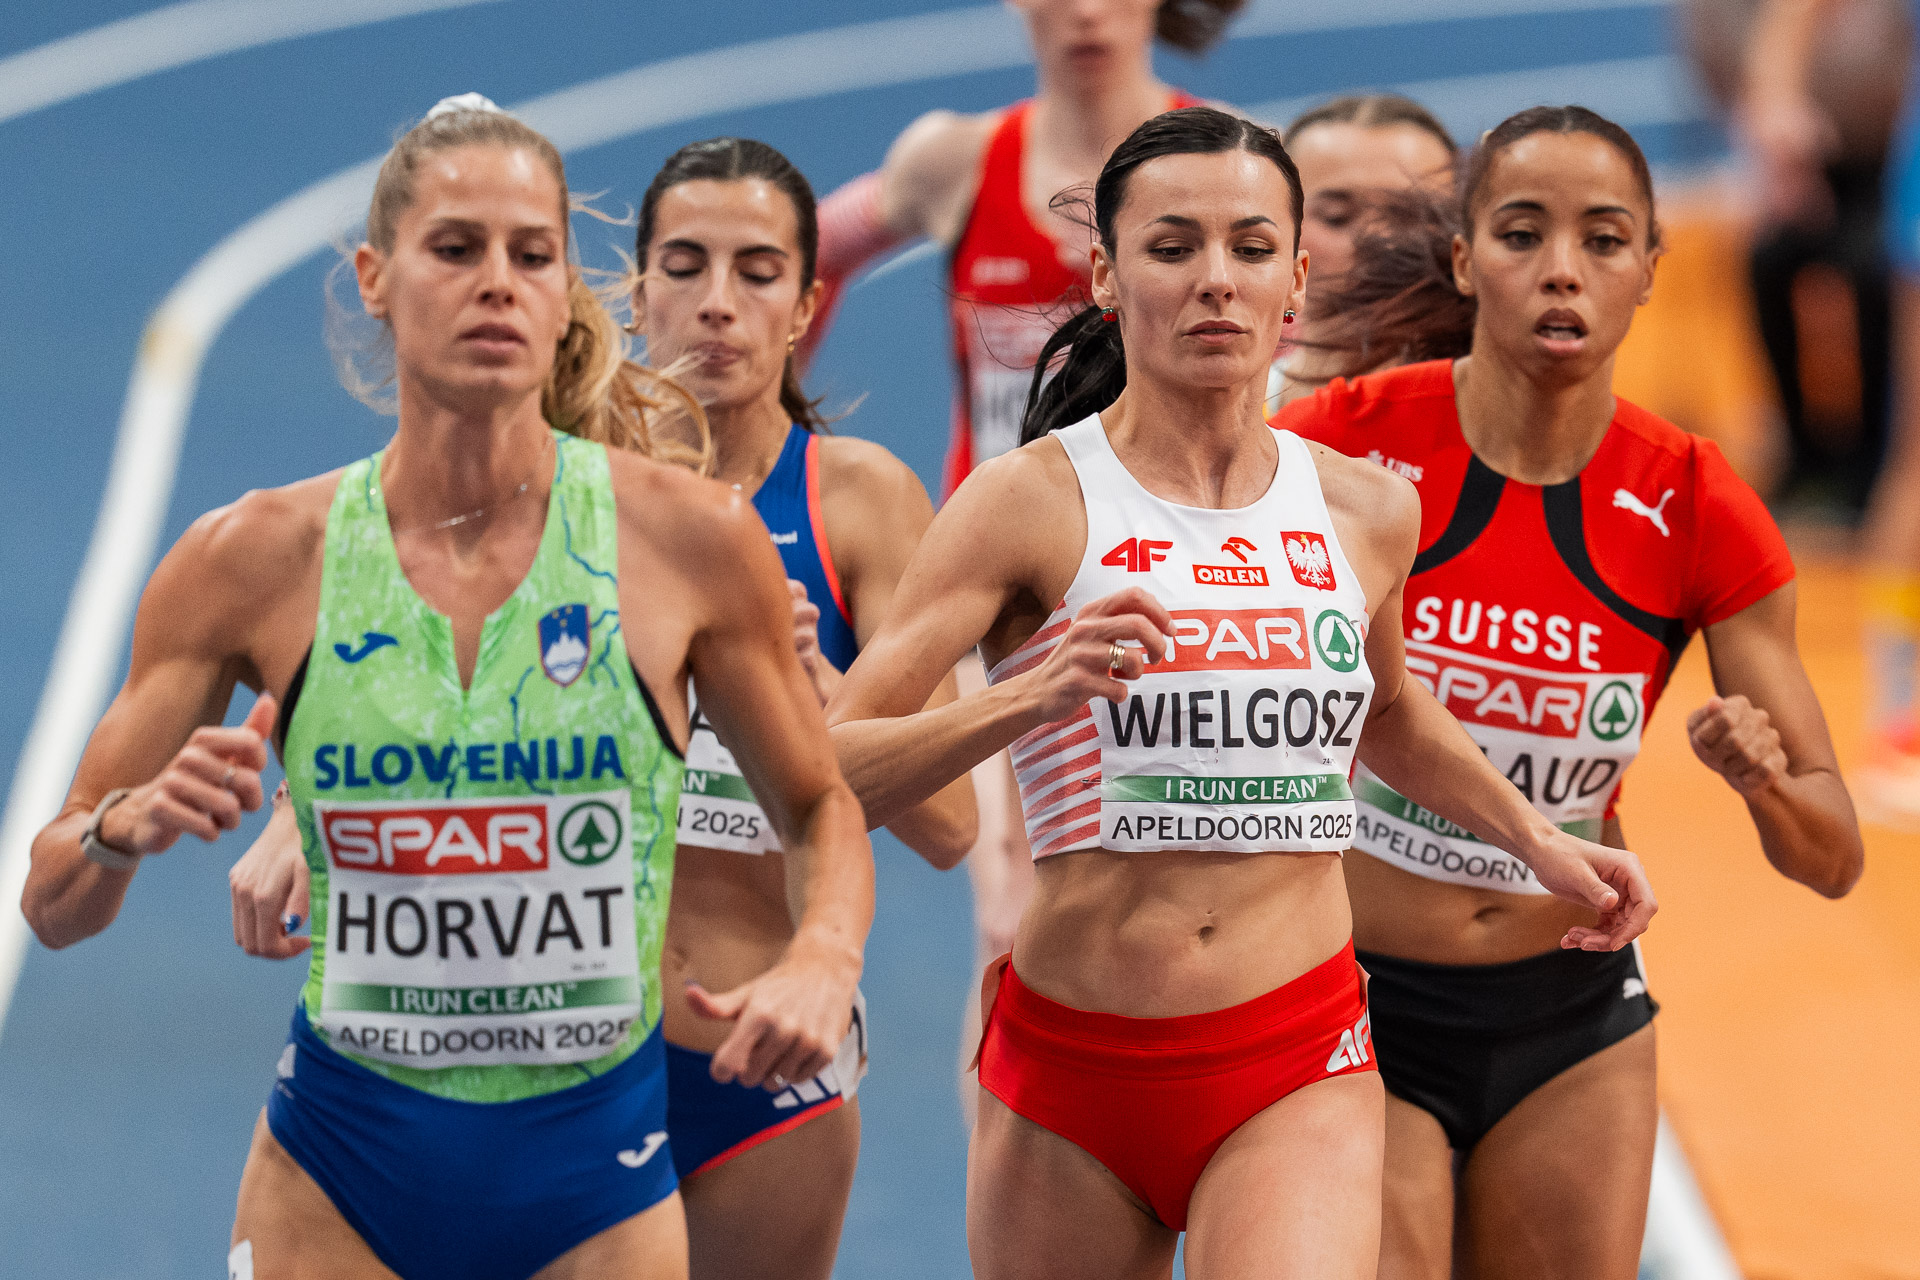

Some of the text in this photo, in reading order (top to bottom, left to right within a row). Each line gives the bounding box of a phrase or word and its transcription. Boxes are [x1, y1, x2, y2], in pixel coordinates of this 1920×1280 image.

[1101, 537, 1173, 572] 4F
[1197, 567, 1264, 584] ORLEN
[1117, 617, 1306, 664] PAR
[1107, 687, 1365, 749] WIELGOSZ
[314, 735, 625, 791] SLOVENIJA
[1480, 745, 1619, 806] AUD
[1165, 779, 1172, 799] I
[1179, 779, 1236, 801] RUN
[1403, 801, 1412, 819] I
[329, 814, 544, 868] SPAR
[691, 808, 760, 840] 2025
[1111, 814, 1353, 841] APELDOORN 2025
[1356, 814, 1529, 883] APELDOORN
[336, 886, 624, 960] HORVAT
[389, 987, 398, 1011] I
[402, 987, 462, 1014] RUN
[339, 1022, 546, 1057] APELDOORN
[1326, 1012, 1370, 1073] 4F
